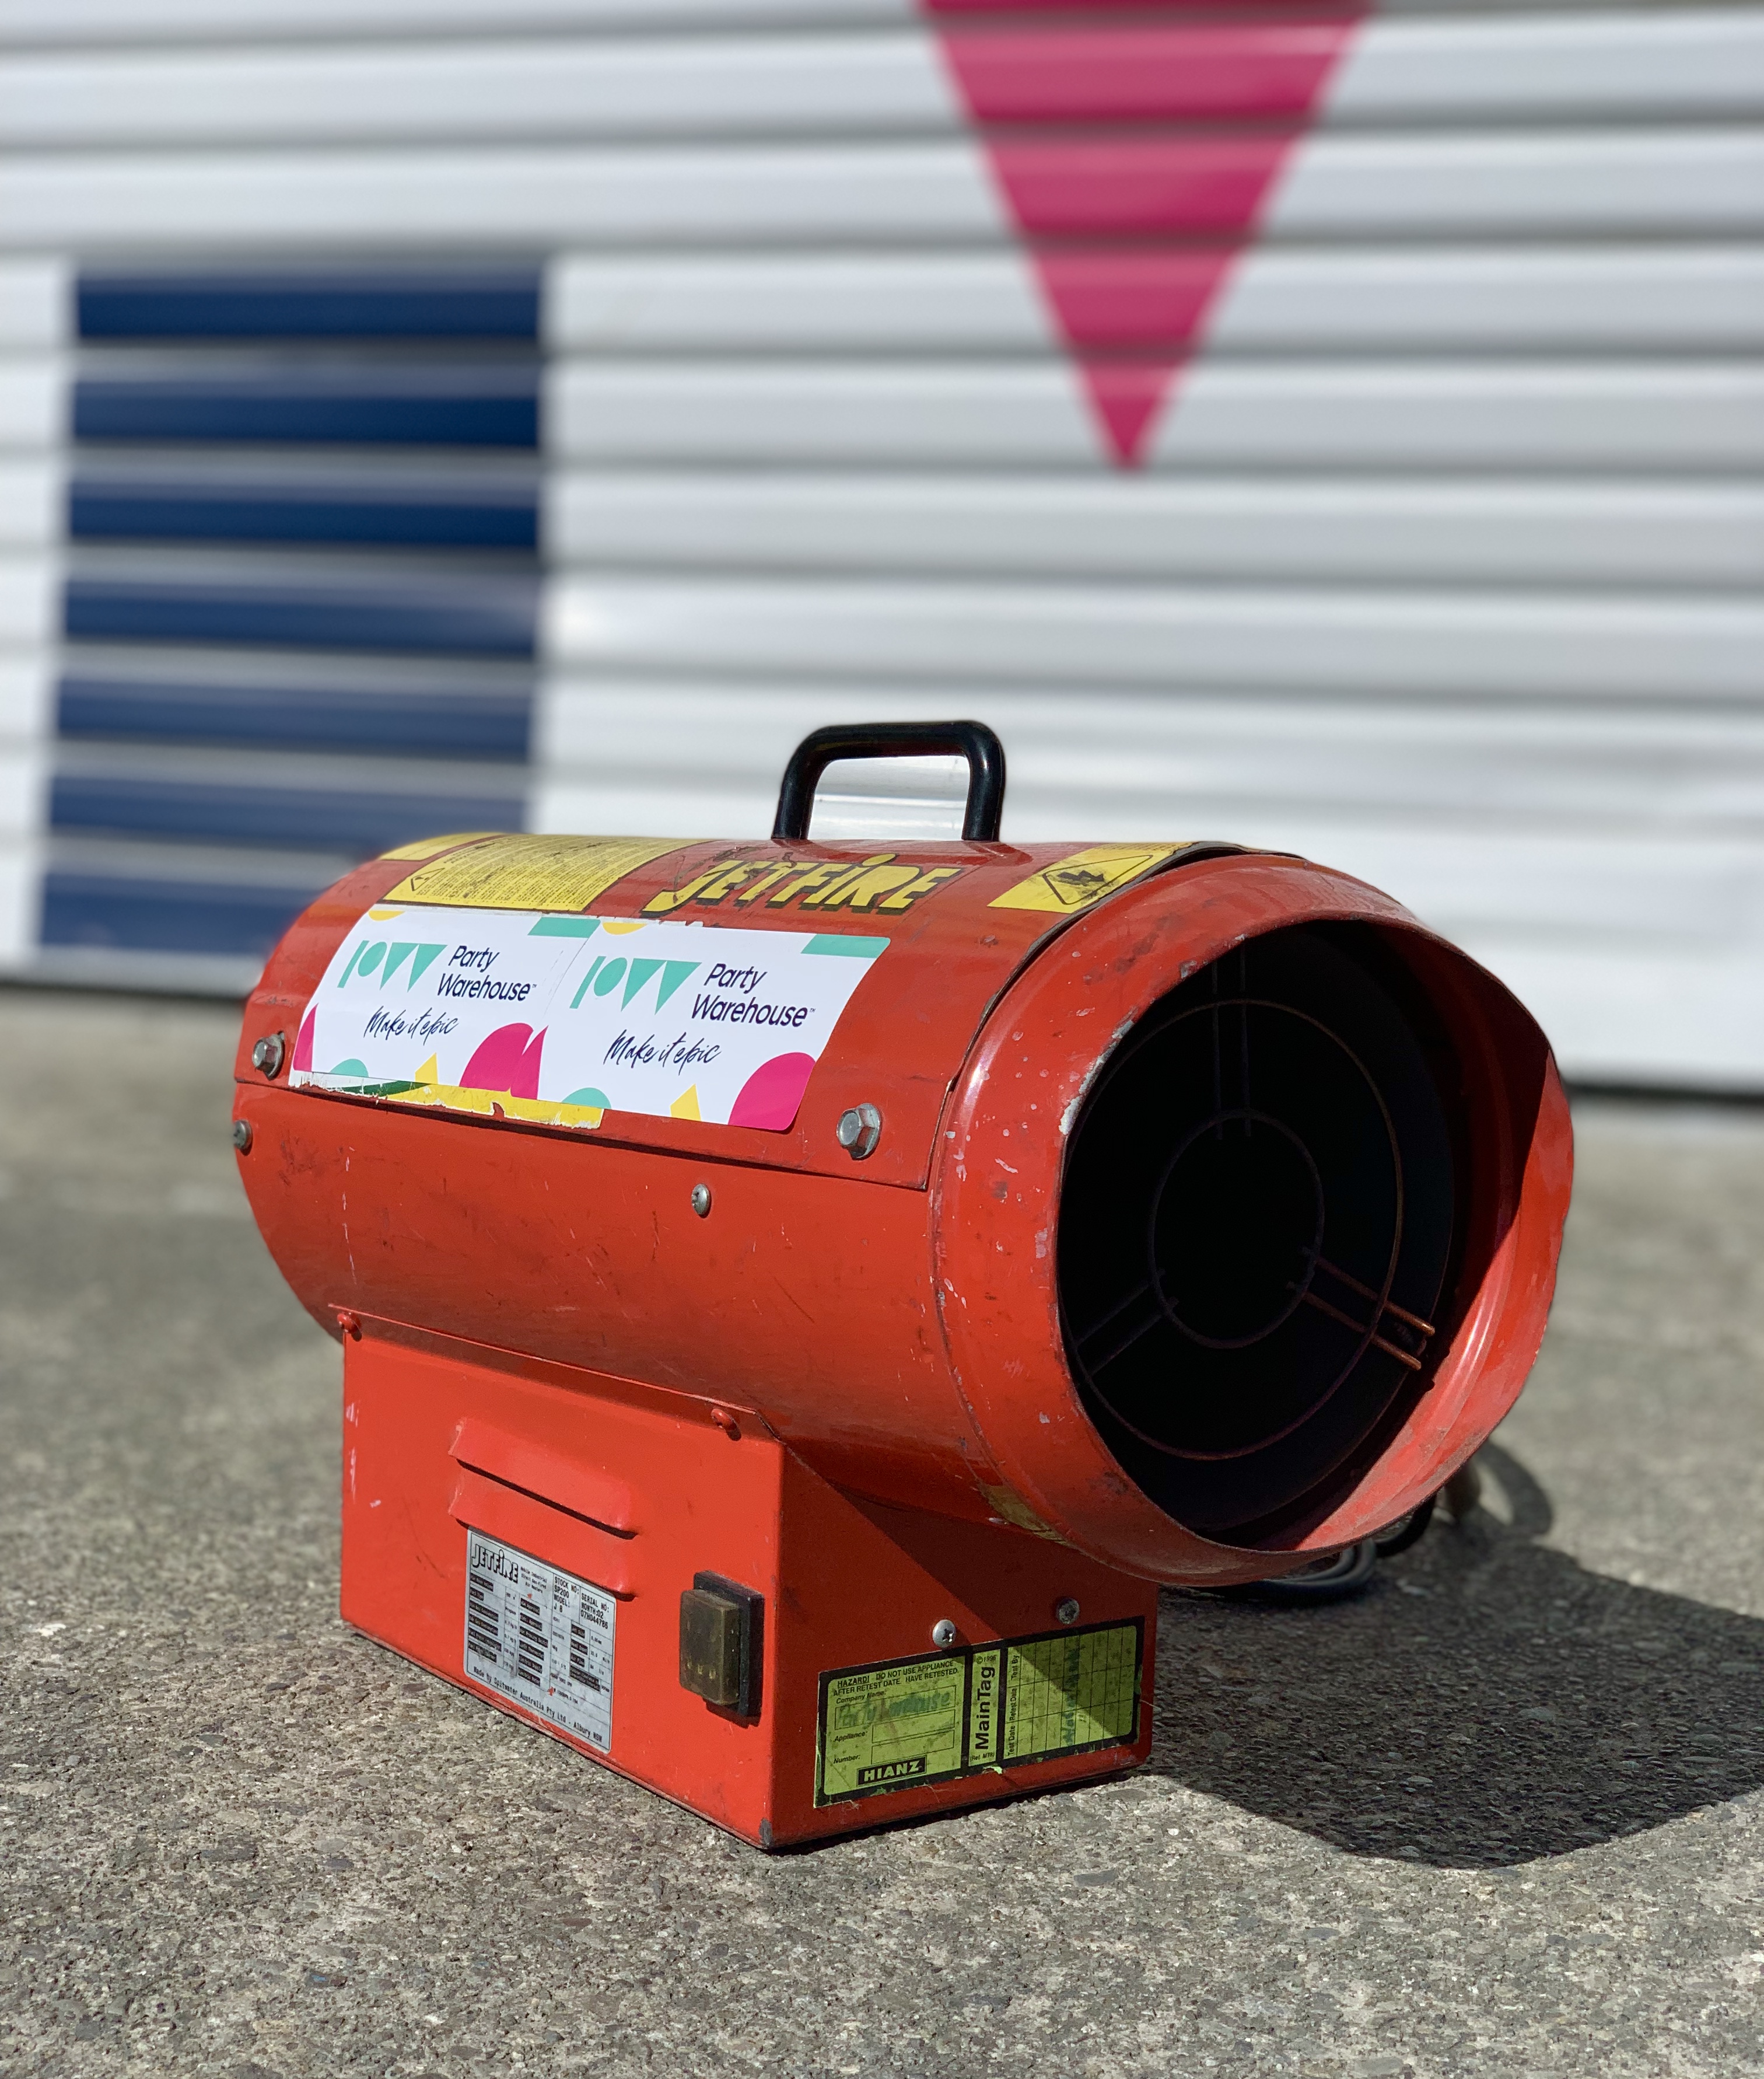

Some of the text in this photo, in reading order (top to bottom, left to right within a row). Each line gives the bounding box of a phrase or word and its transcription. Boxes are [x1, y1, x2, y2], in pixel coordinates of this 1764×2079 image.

[448, 945, 500, 973] Party
[704, 963, 768, 994] Party
[363, 1006, 459, 1046] Make it epic
[603, 1029, 722, 1076] Make it epic
[554, 1576, 569, 1589] STOCK
[554, 1585, 569, 1598] SP200
[554, 1594, 570, 1608] MODEL:
[581, 1593, 598, 1608] SERIAL
[876, 1672, 886, 1680] DO
[887, 1669, 902, 1678] NOT
[903, 1667, 916, 1675] USE
[917, 1660, 954, 1673] APPLIANCE
[1012, 1655, 1020, 1664] By
[833, 1687, 855, 1696] AFTER
[856, 1681, 882, 1693] RETEST
[905, 1673, 922, 1682] HAVE
[836, 1689, 887, 1704] Company Name:
[520, 1692, 544, 1711] Australia
[546, 1706, 555, 1718] Pty
[557, 1712, 566, 1723] Ltd
[573, 1721, 591, 1739] Albury
[975, 1667, 995, 1749] MainTag
[833, 1753, 861, 1764] Number:
[863, 1760, 920, 1782] HIANZ
